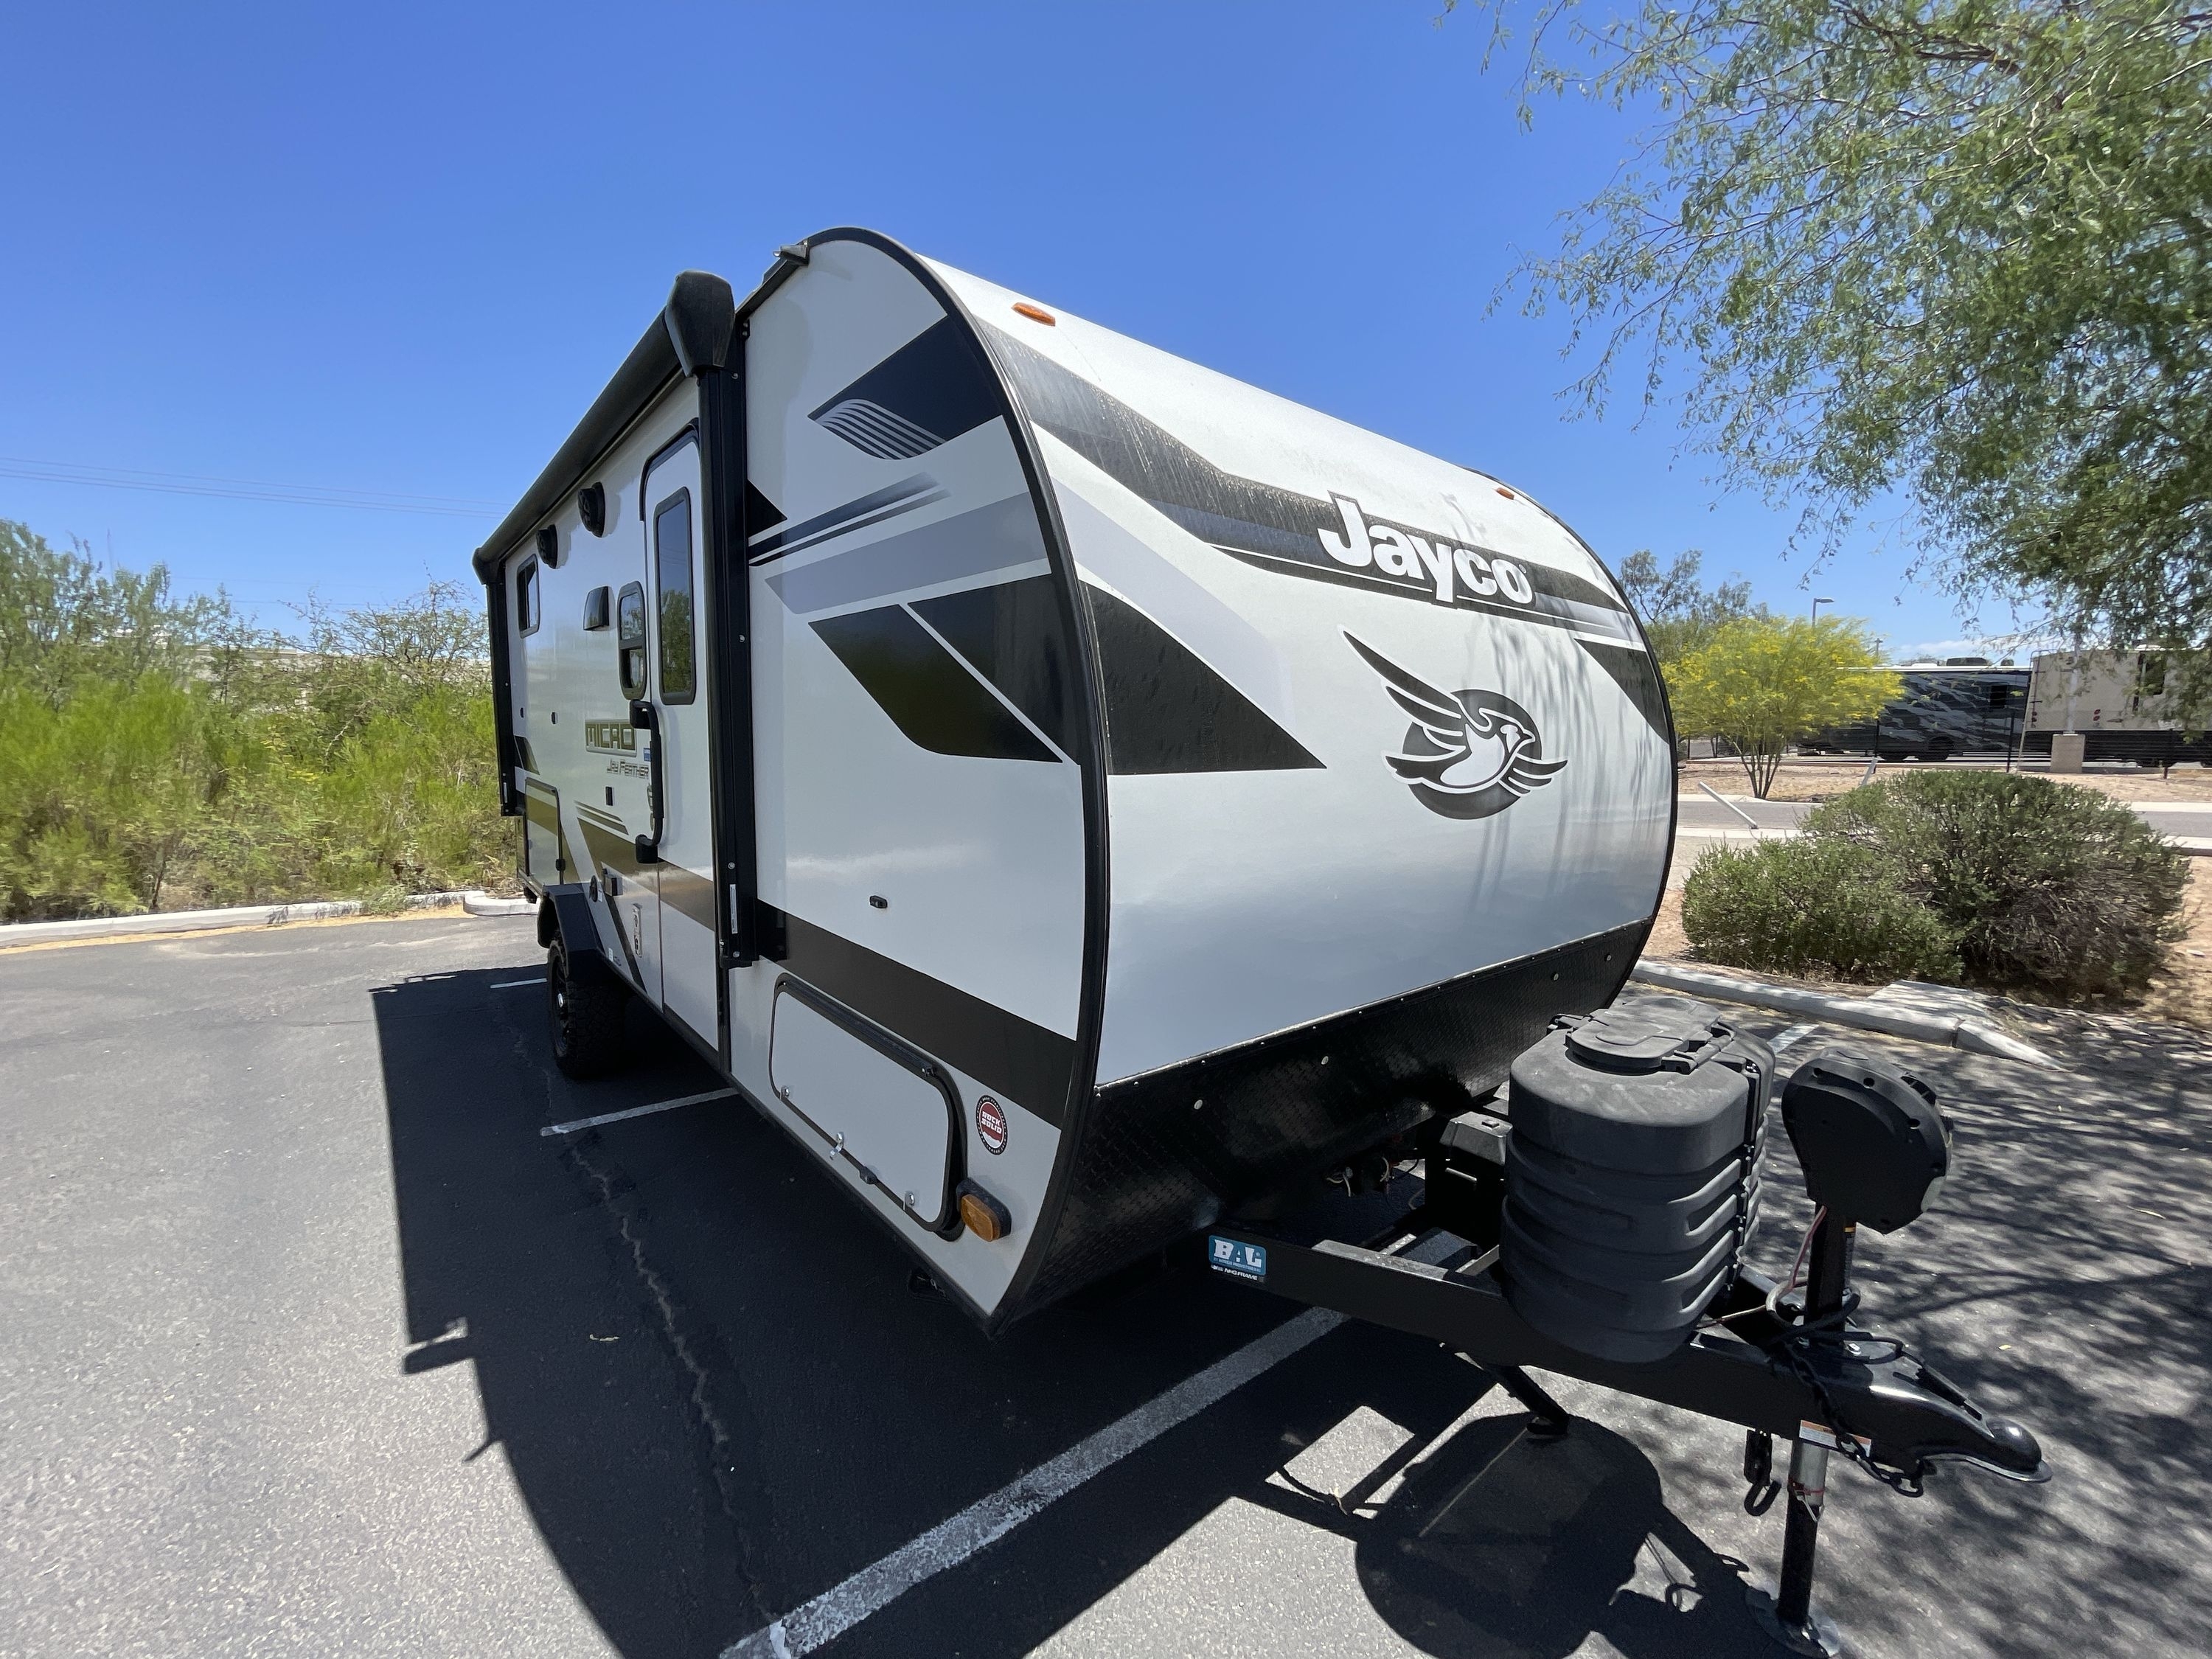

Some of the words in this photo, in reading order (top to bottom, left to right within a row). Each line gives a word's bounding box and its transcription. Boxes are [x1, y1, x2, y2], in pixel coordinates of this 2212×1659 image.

[1317, 496, 1534, 604] Jayco
[586, 723, 636, 751] MICRO
[981, 1117, 1002, 1134] SOLID
[982, 1110, 1001, 1127] ROCK
[1214, 1239, 1262, 1267] BAL
